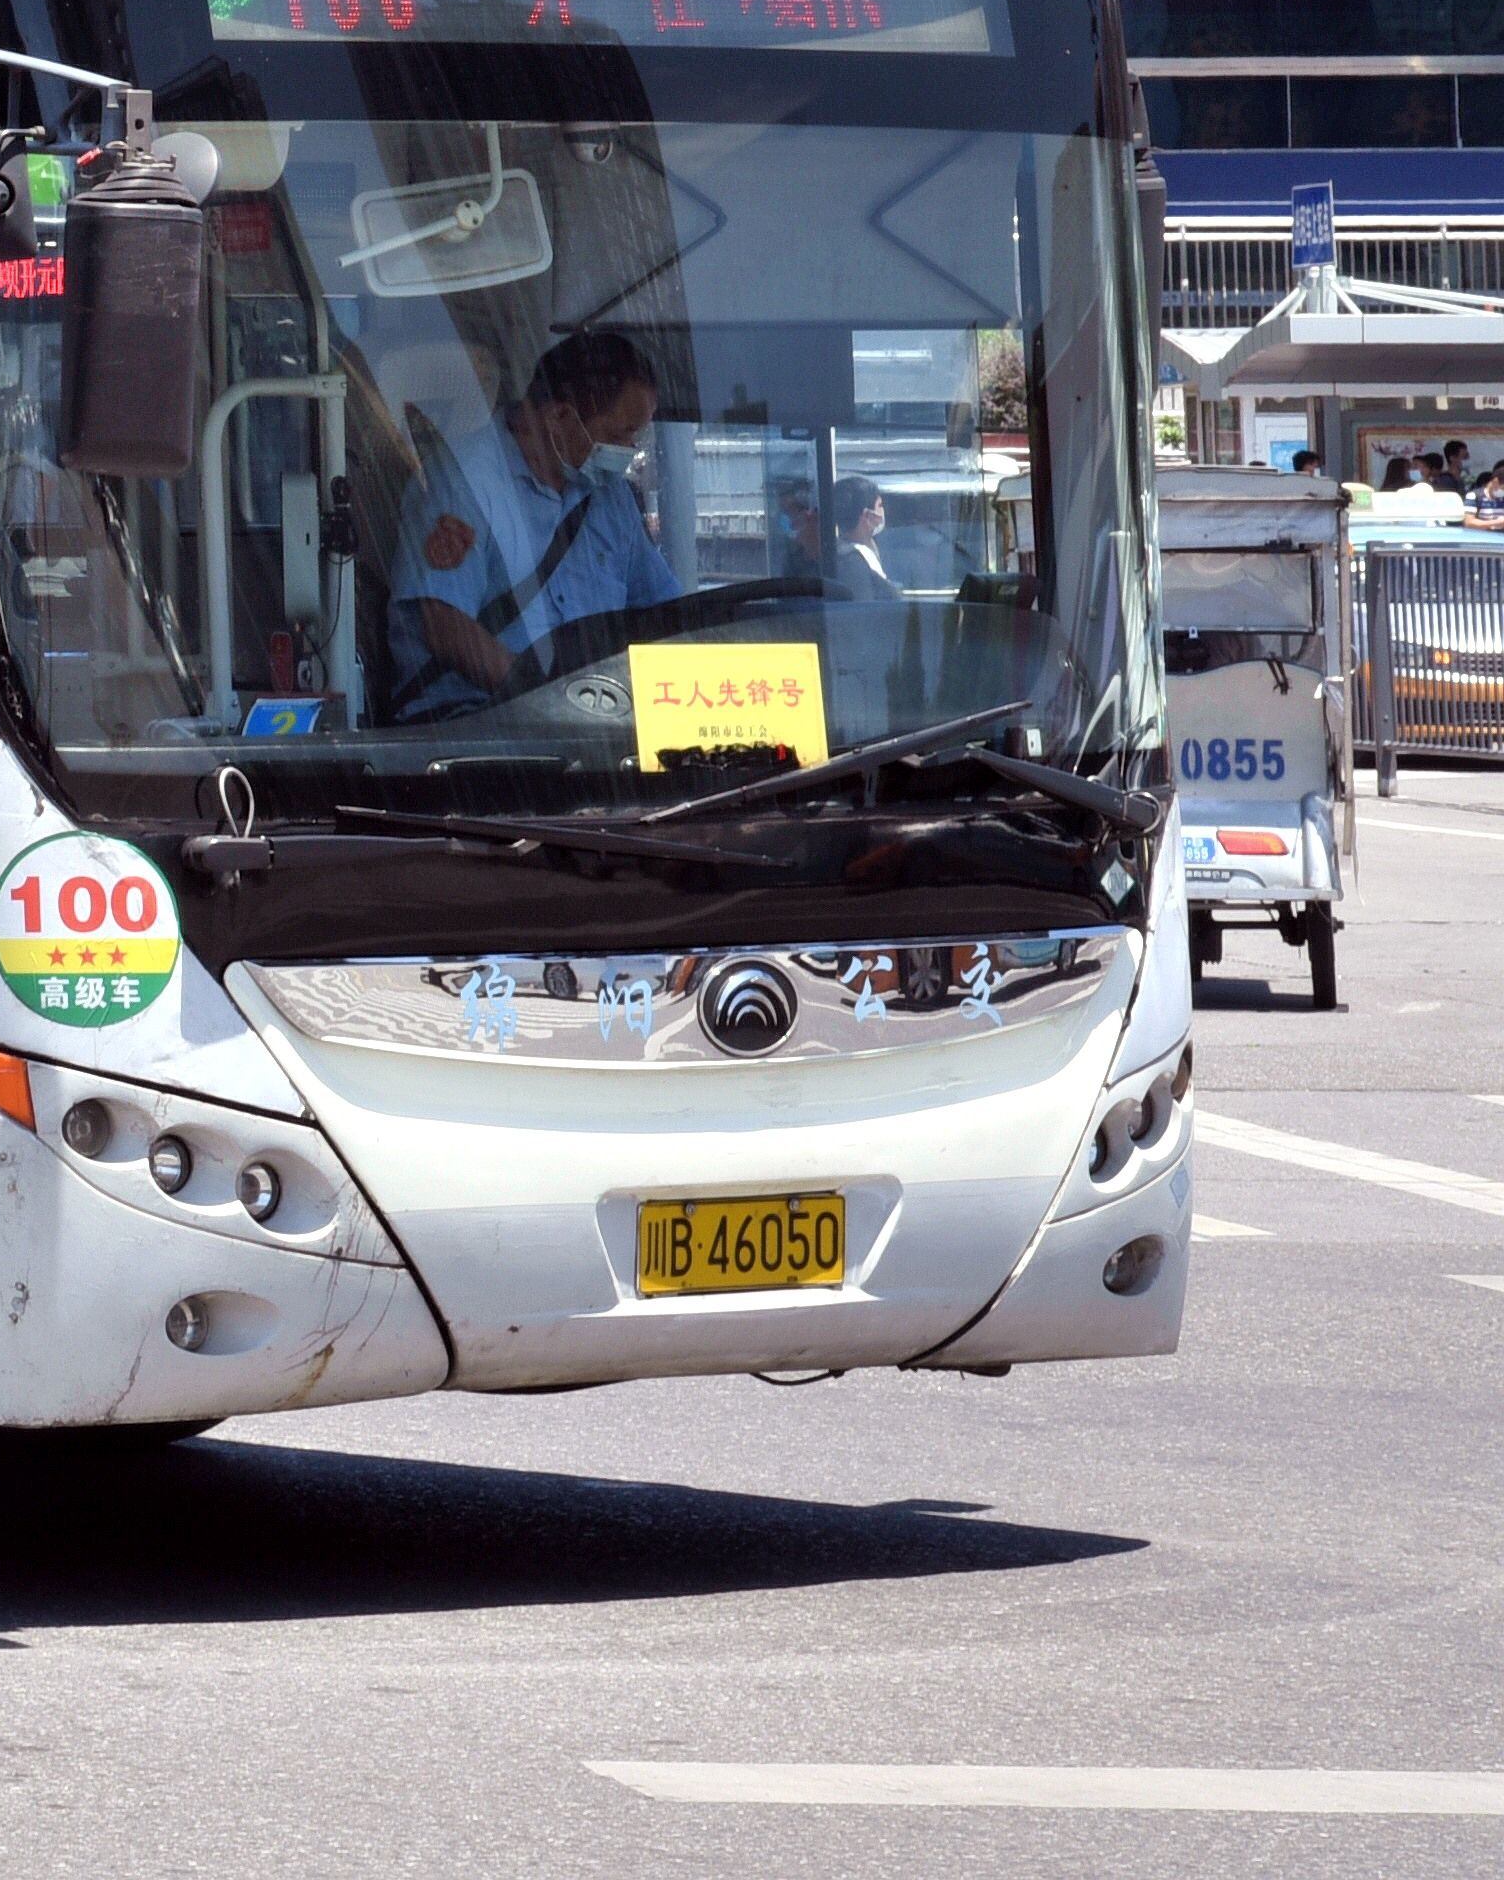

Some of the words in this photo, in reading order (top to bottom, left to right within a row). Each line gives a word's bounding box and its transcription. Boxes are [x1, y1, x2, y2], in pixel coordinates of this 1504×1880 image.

[653, 677, 805, 709] 工人先锋号
[698, 724, 769, 739] 绵阳市总工会
[1180, 738, 1286, 782] 0855
[10, 875, 158, 934] 100
[37, 976, 141, 1010] 高级车
